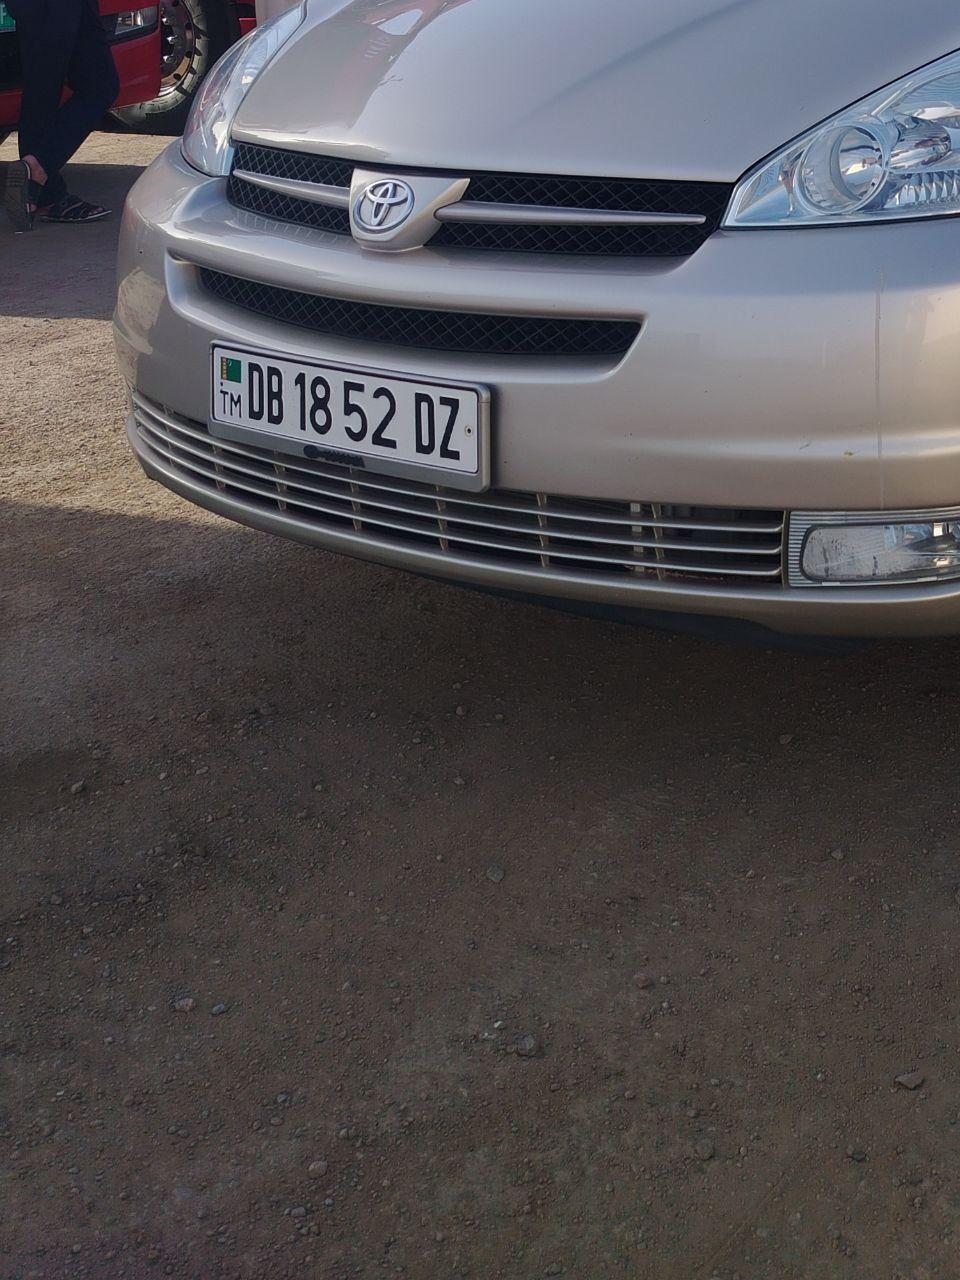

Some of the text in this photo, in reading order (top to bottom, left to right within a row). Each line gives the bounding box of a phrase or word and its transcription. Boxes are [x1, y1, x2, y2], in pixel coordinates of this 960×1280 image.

[220, 361, 461, 461] TM DB 18 52 DZ
